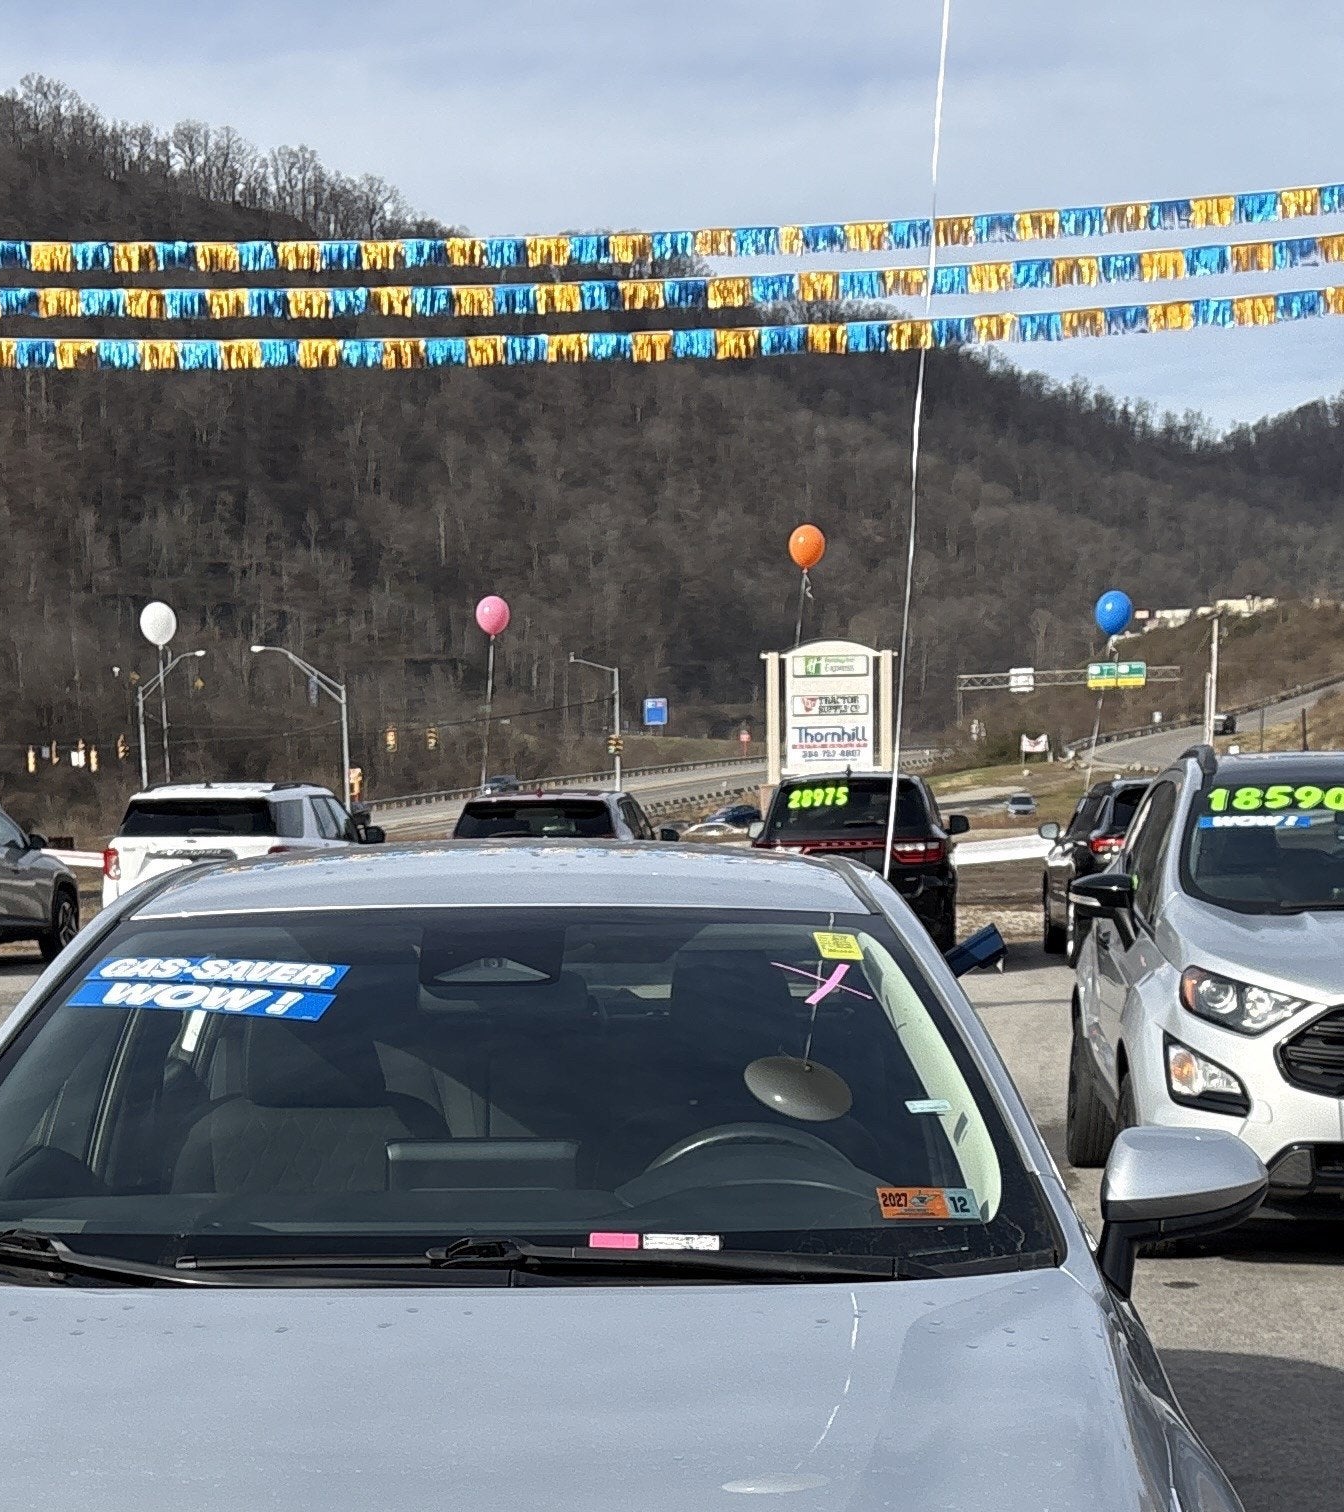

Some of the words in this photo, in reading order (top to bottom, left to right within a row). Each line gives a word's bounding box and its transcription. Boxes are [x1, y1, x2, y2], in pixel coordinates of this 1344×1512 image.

[792, 725, 868, 742] Thornhill
[787, 786, 849, 808] 28975
[880, 1192, 908, 1207] 2027
[949, 1196, 970, 1213] 12
